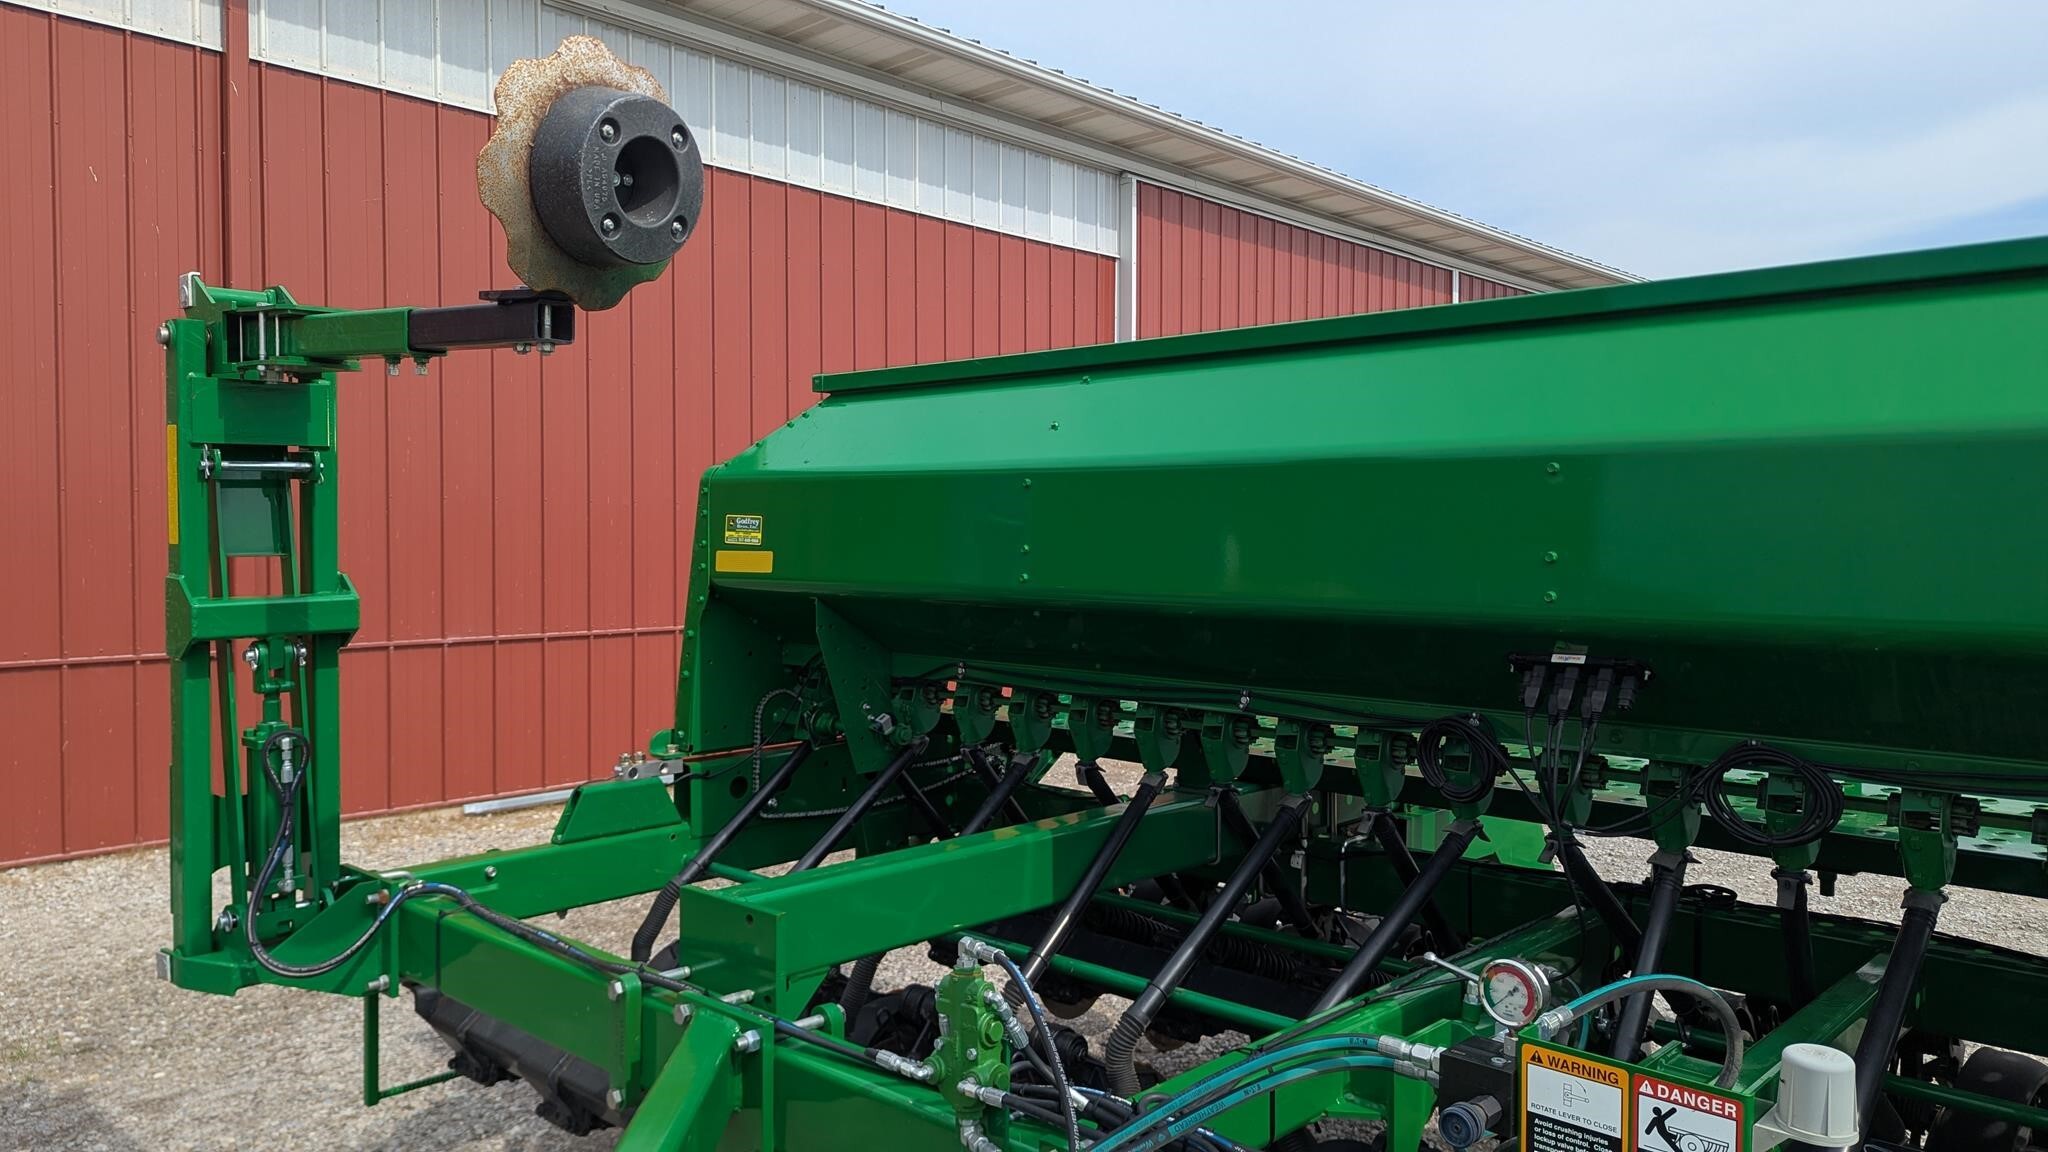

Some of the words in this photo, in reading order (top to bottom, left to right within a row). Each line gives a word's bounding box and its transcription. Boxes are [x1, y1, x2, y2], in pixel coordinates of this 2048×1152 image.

[1546, 1054, 1619, 1085] WARNING
[1174, 1101, 1226, 1132] WEATHERHEAD
[1657, 1084, 1737, 1118] DANGER
[1530, 1102, 1557, 1115] ROTATE
[1558, 1110, 1581, 1123] LEVER
[1582, 1117, 1592, 1126] TO
[1593, 1121, 1618, 1133] CLOSE
[1534, 1118, 1553, 1129] Avoid
[1553, 1124, 1583, 1139] crushing
[1583, 1133, 1609, 1146] injuries
[1542, 1128, 1556, 1138] loss
[1534, 1133, 1556, 1146] lockup
[1556, 1141, 1574, 1151] valve
